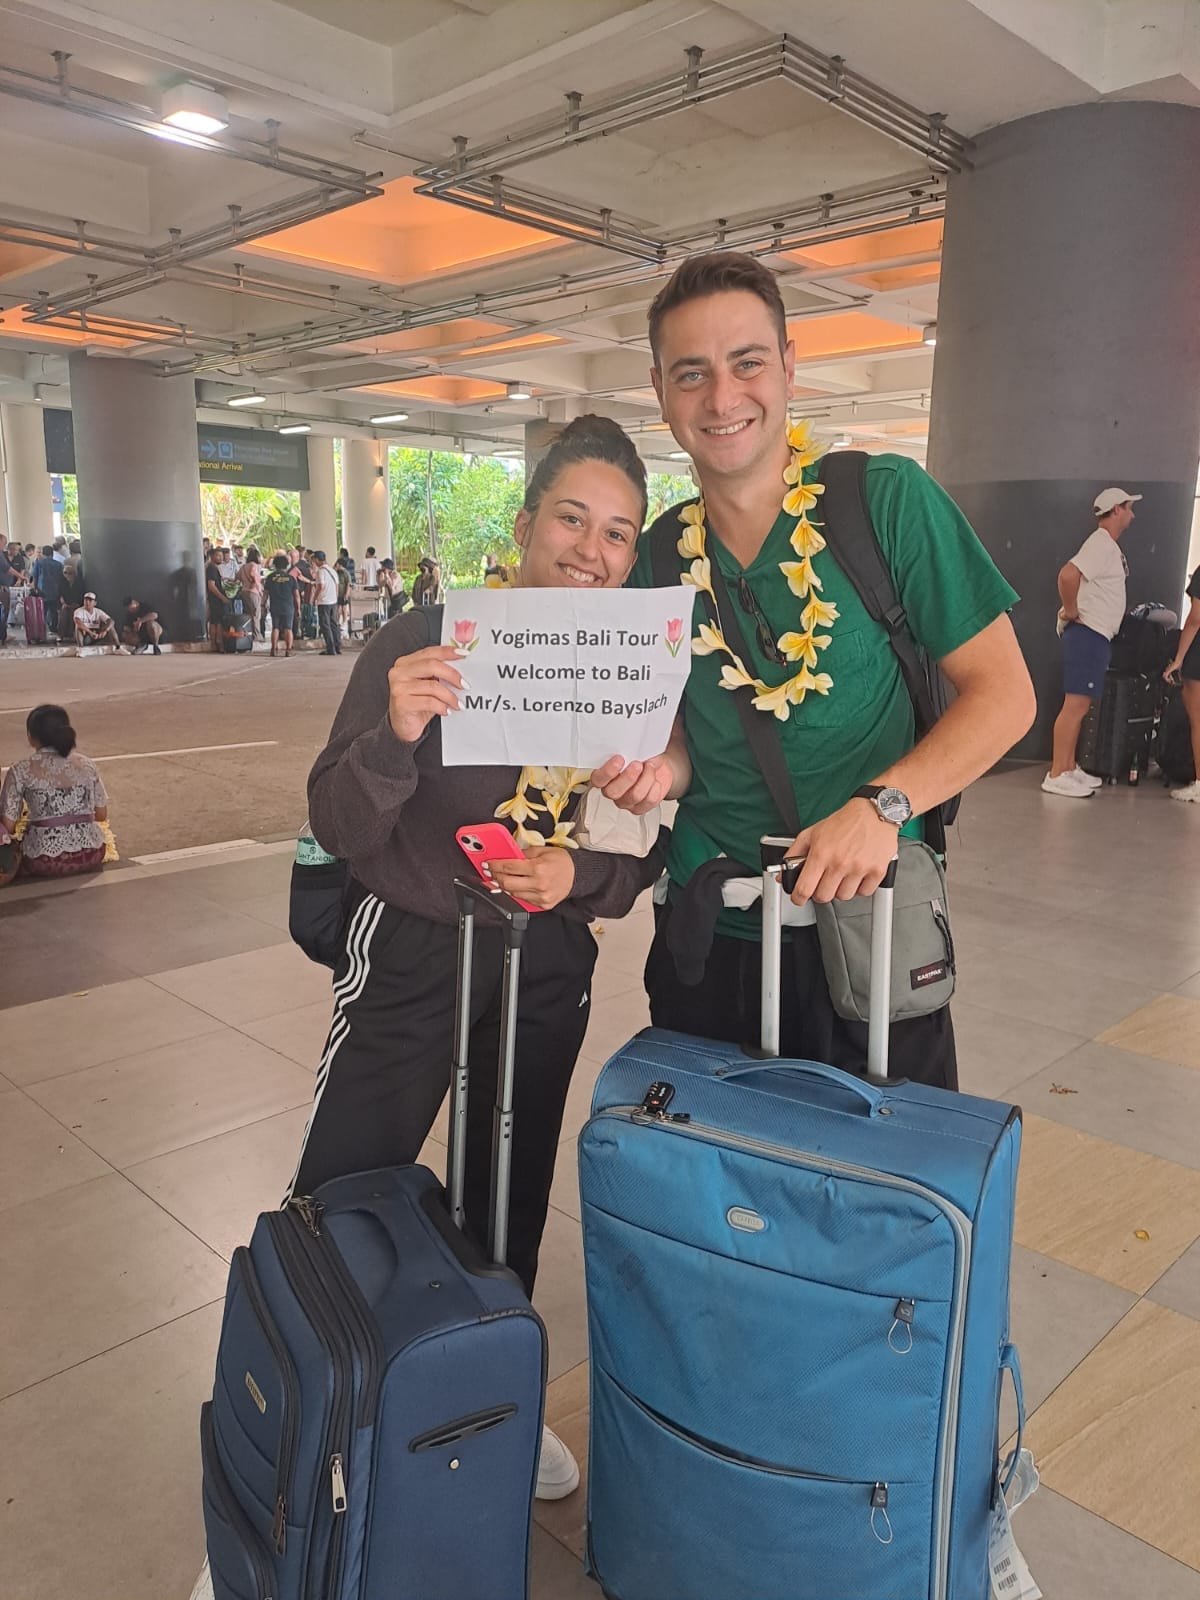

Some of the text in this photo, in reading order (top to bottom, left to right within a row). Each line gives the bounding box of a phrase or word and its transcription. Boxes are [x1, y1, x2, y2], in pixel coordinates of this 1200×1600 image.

[491, 629, 658, 649] Yogimas Bali Tour
[497, 663, 651, 681] Welcome to Bali
[465, 693, 667, 719] Mr/s. Lorenzo Bayslach
[917, 969, 942, 981] EASTPAK
